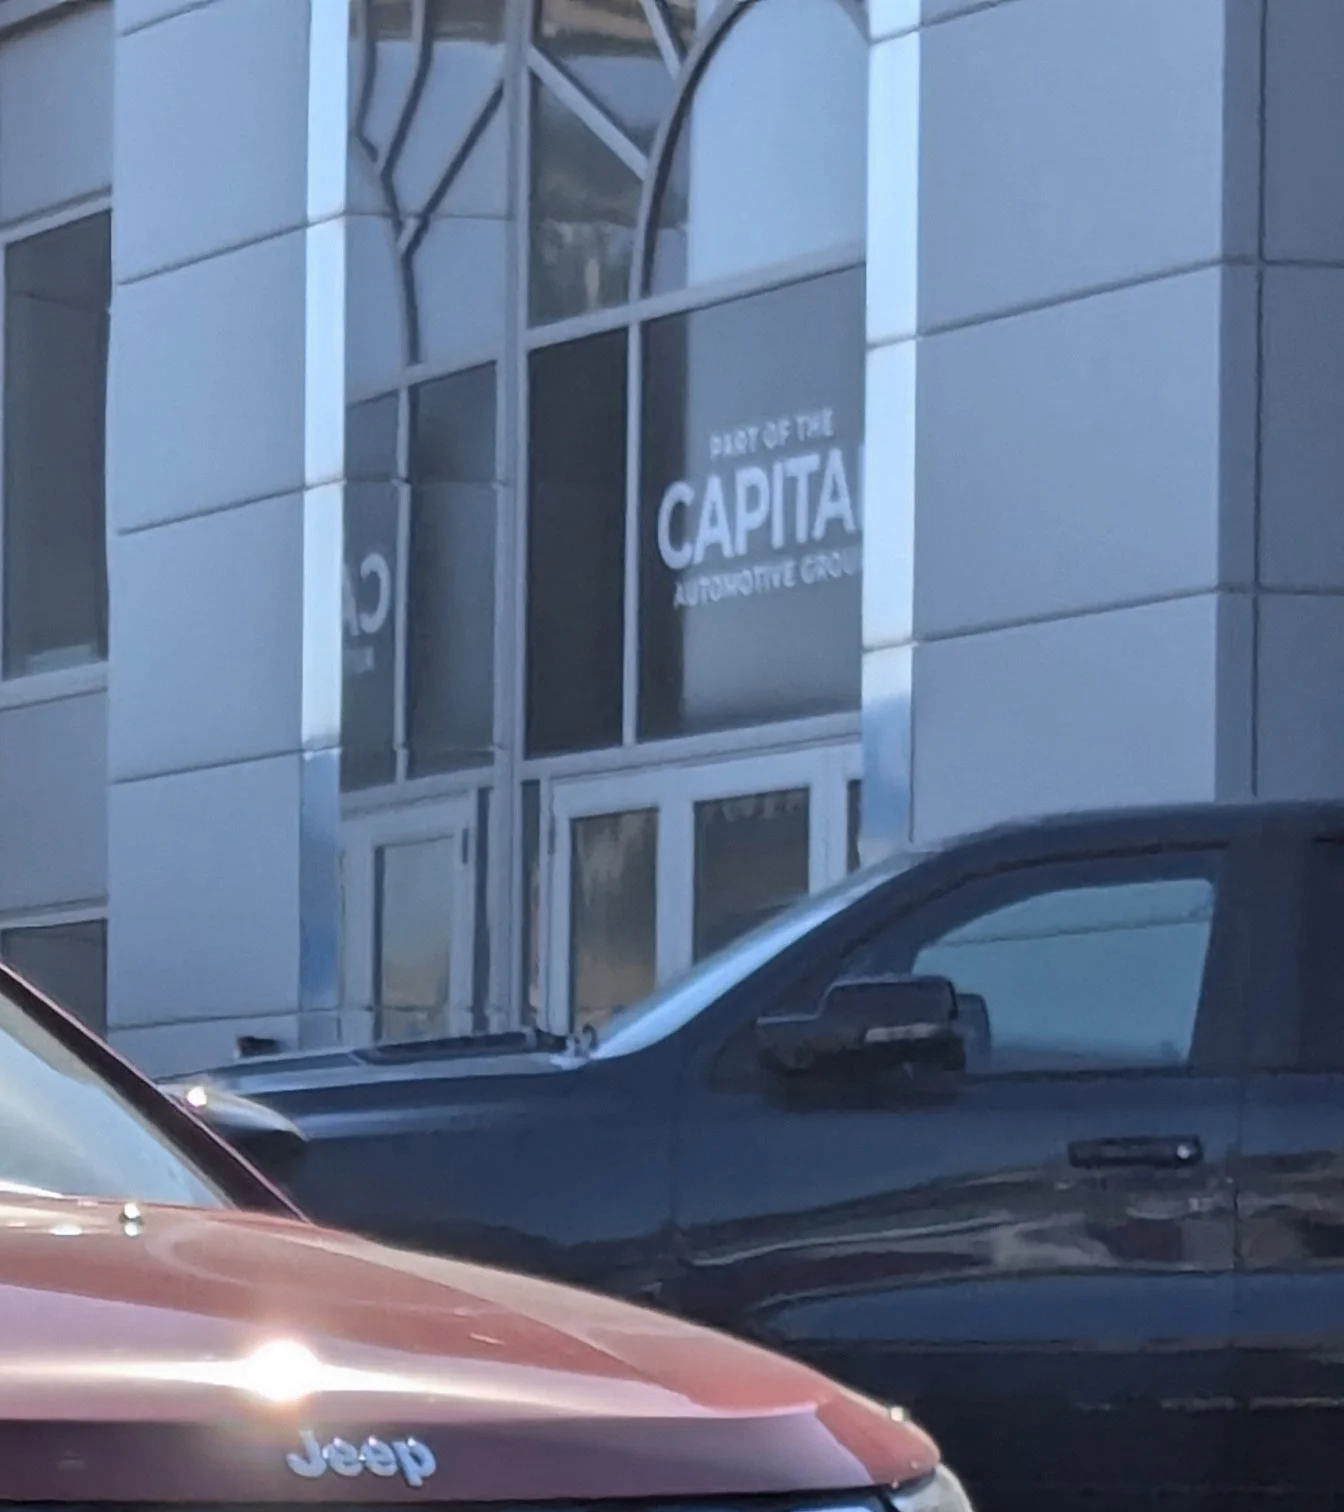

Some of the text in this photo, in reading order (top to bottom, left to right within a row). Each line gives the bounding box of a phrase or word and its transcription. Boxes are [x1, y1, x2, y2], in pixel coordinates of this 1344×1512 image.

[709, 409, 834, 461] PART OF THE
[658, 448, 864, 569] CAPITA
[673, 550, 861, 608] AUTOMOTIVE GROU
[286, 1429, 437, 1487] Jeep
